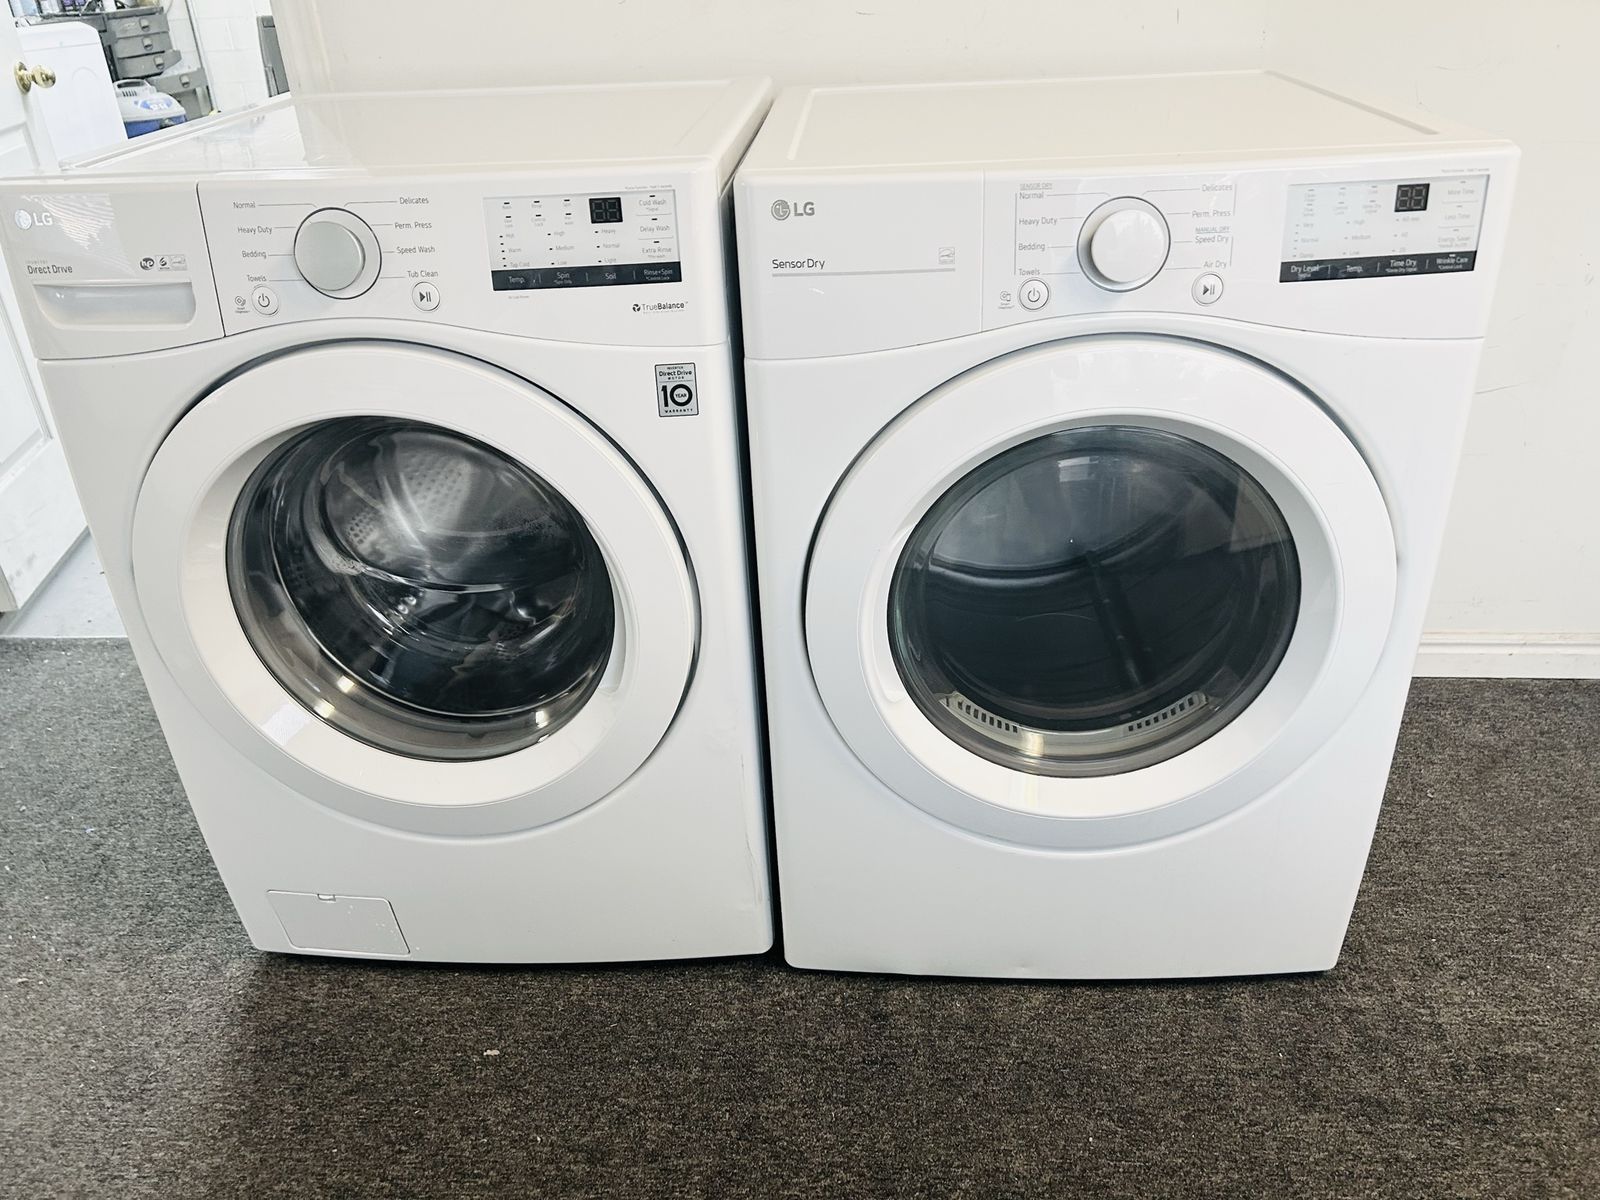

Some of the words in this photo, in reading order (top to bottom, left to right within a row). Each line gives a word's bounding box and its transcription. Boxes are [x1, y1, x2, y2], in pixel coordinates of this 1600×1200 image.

[1202, 184, 1233, 192] Delicates
[400, 196, 429, 205] Delicates
[1019, 192, 1044, 200] Normal
[794, 202, 815, 217] LG
[1192, 210, 1210, 218] Perm.
[33, 212, 53, 226] LG
[1018, 218, 1040, 226] Heavy
[1041, 216, 1058, 225] Duty
[238, 226, 256, 234] Heavy
[258, 226, 272, 234] Duty
[394, 222, 412, 230] Perm.
[414, 221, 432, 229] Press
[1195, 236, 1216, 245] Speed
[1216, 235, 1229, 244] Dry
[396, 246, 417, 255] Speed
[418, 246, 436, 254] Wash
[1018, 243, 1046, 252] Bedding
[242, 250, 267, 260] Bedding
[772, 258, 806, 269] Sensor
[807, 258, 826, 270] Dry
[1215, 260, 1227, 269] Dry
[1390, 260, 1404, 268] Time
[1405, 259, 1417, 268] Dry
[27, 264, 52, 274] Direct
[52, 264, 73, 274] Drive
[1018, 268, 1041, 276] Towels
[1290, 265, 1302, 274] Dry
[1303, 264, 1320, 272] Level
[408, 270, 419, 278] Tub
[420, 270, 438, 278] Clean
[556, 272, 570, 280] Spin
[605, 272, 617, 280] Soil
[508, 276, 525, 284] Temp.
[641, 302, 685, 311] TrueBalance
[661, 384, 693, 408] 10
